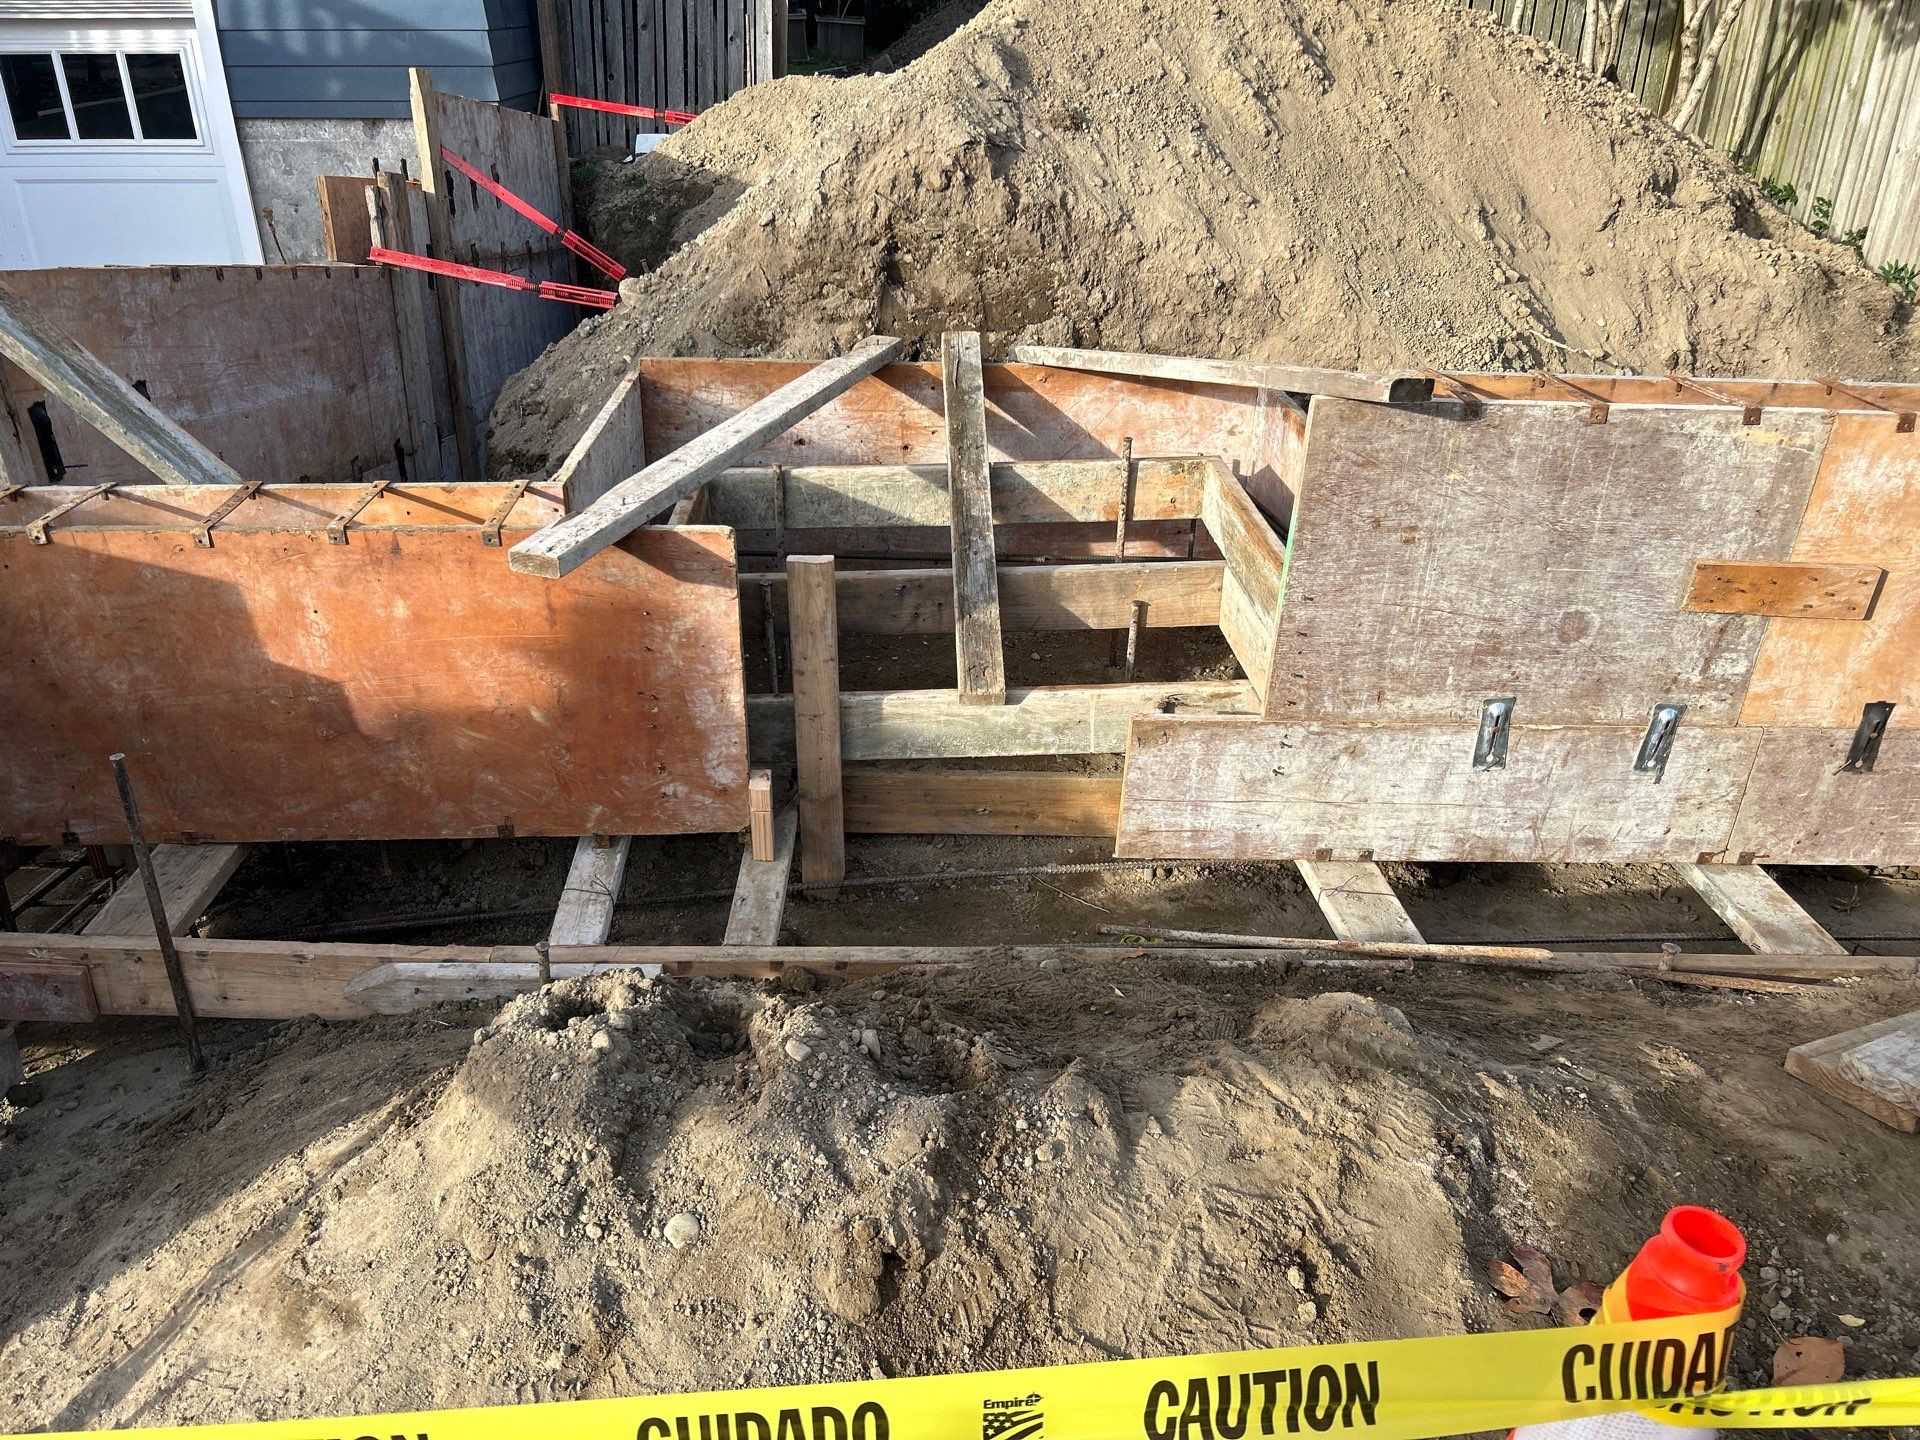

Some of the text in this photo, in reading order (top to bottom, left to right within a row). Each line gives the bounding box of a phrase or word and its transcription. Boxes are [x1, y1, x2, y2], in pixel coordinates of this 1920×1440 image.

[1144, 1361, 1380, 1440] CAUTION
[1562, 1321, 1739, 1403] CUIDA
[983, 1397, 1034, 1409] Empire
